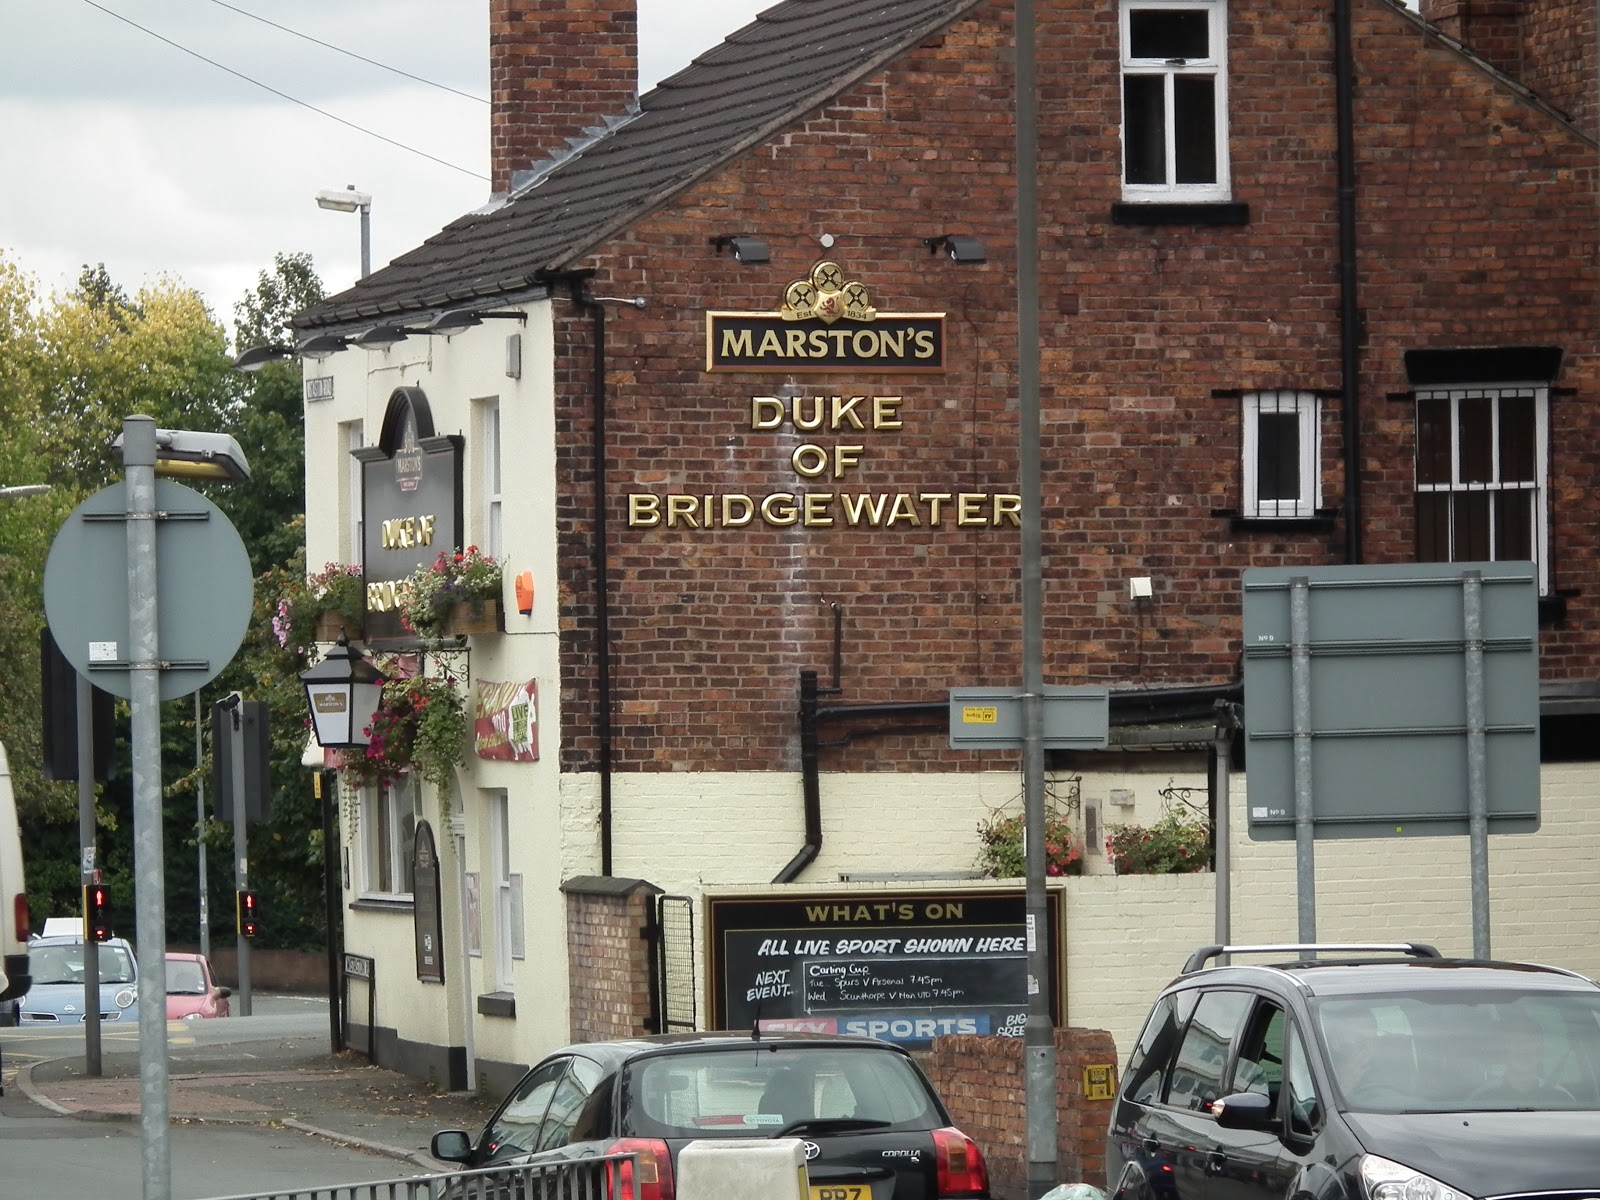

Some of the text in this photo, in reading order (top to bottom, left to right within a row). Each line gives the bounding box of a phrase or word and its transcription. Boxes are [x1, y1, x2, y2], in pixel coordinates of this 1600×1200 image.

[796, 310, 867, 320] Est 1834
[721, 327, 935, 359] MARSTON'S
[751, 396, 904, 430] DUKE
[791, 444, 865, 478] OF
[628, 492, 1022, 528] BRIDGEWATER
[806, 903, 964, 922] WHAT'S ON
[758, 936, 1026, 956] ALL LIVE SPORT SHOWN HERE
[755, 969, 791, 986] NEXT
[809, 963, 868, 979] Carling Cup
[834, 978, 860, 989] Spurs
[872, 977, 904, 986] Arsenal
[807, 991, 827, 1001] Wed
[839, 989, 886, 1002] Scunthorpe
[846, 1018, 976, 1038] SPORTS
[1006, 1013, 1027, 1027] BIG
[881, 1149, 921, 1157] COROLLA
